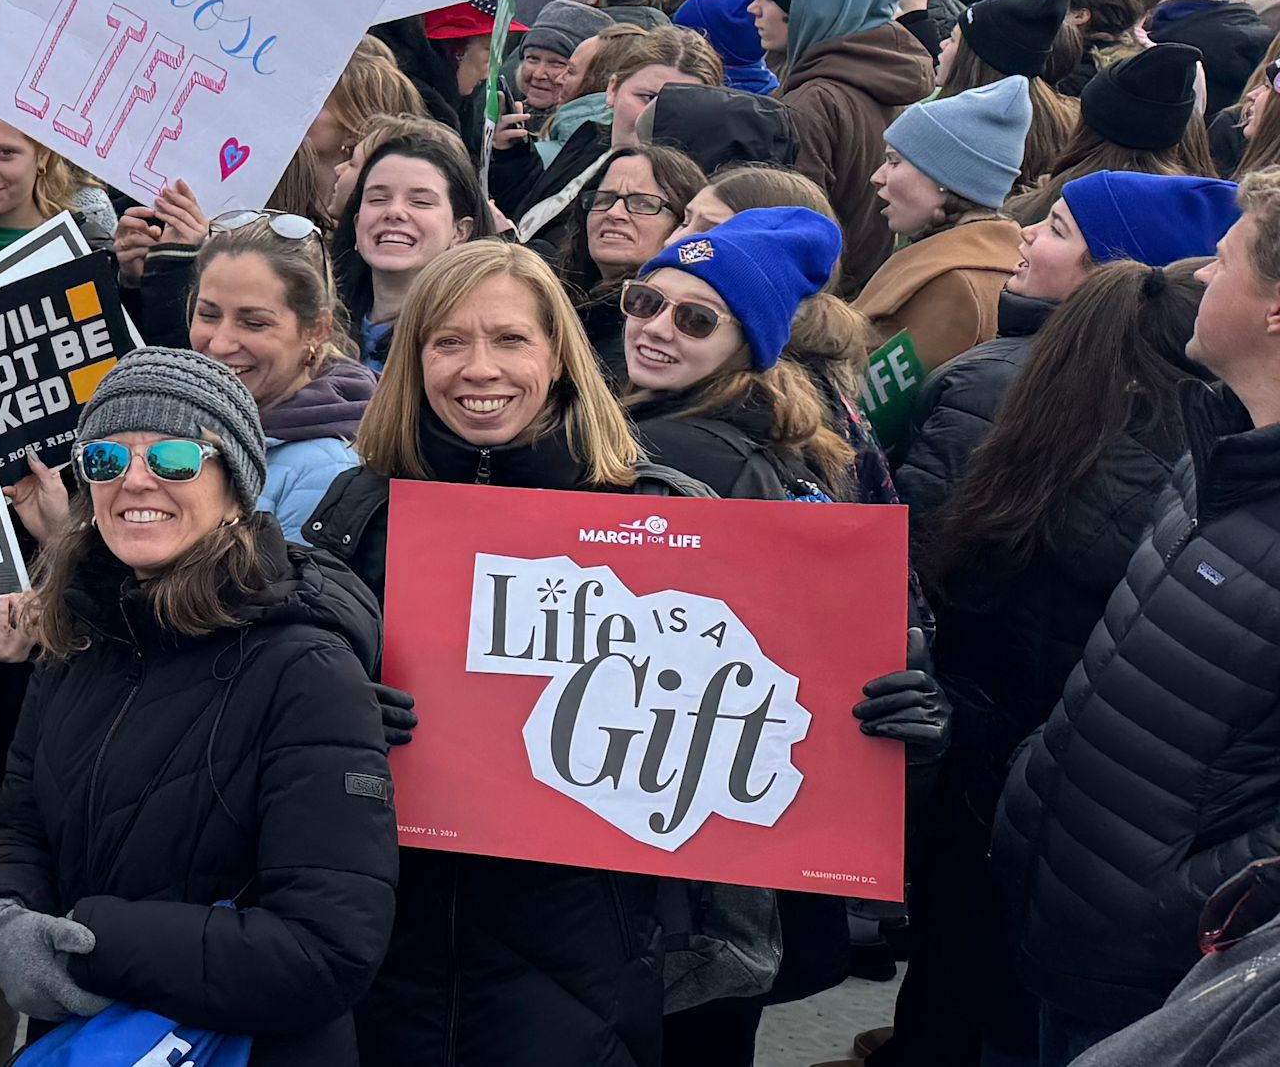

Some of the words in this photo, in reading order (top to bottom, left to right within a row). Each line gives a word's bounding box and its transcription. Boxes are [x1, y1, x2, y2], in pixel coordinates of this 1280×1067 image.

[49, 318, 115, 371] BE
[578, 528, 644, 547] MARCH
[646, 535, 666, 545] FOR
[668, 533, 702, 550] LIFE
[483, 571, 639, 666] Life
[651, 607, 689, 635] IS
[699, 620, 728, 648] A
[548, 652, 788, 835] Gift
[801, 869, 861, 883] WASHINGTON
